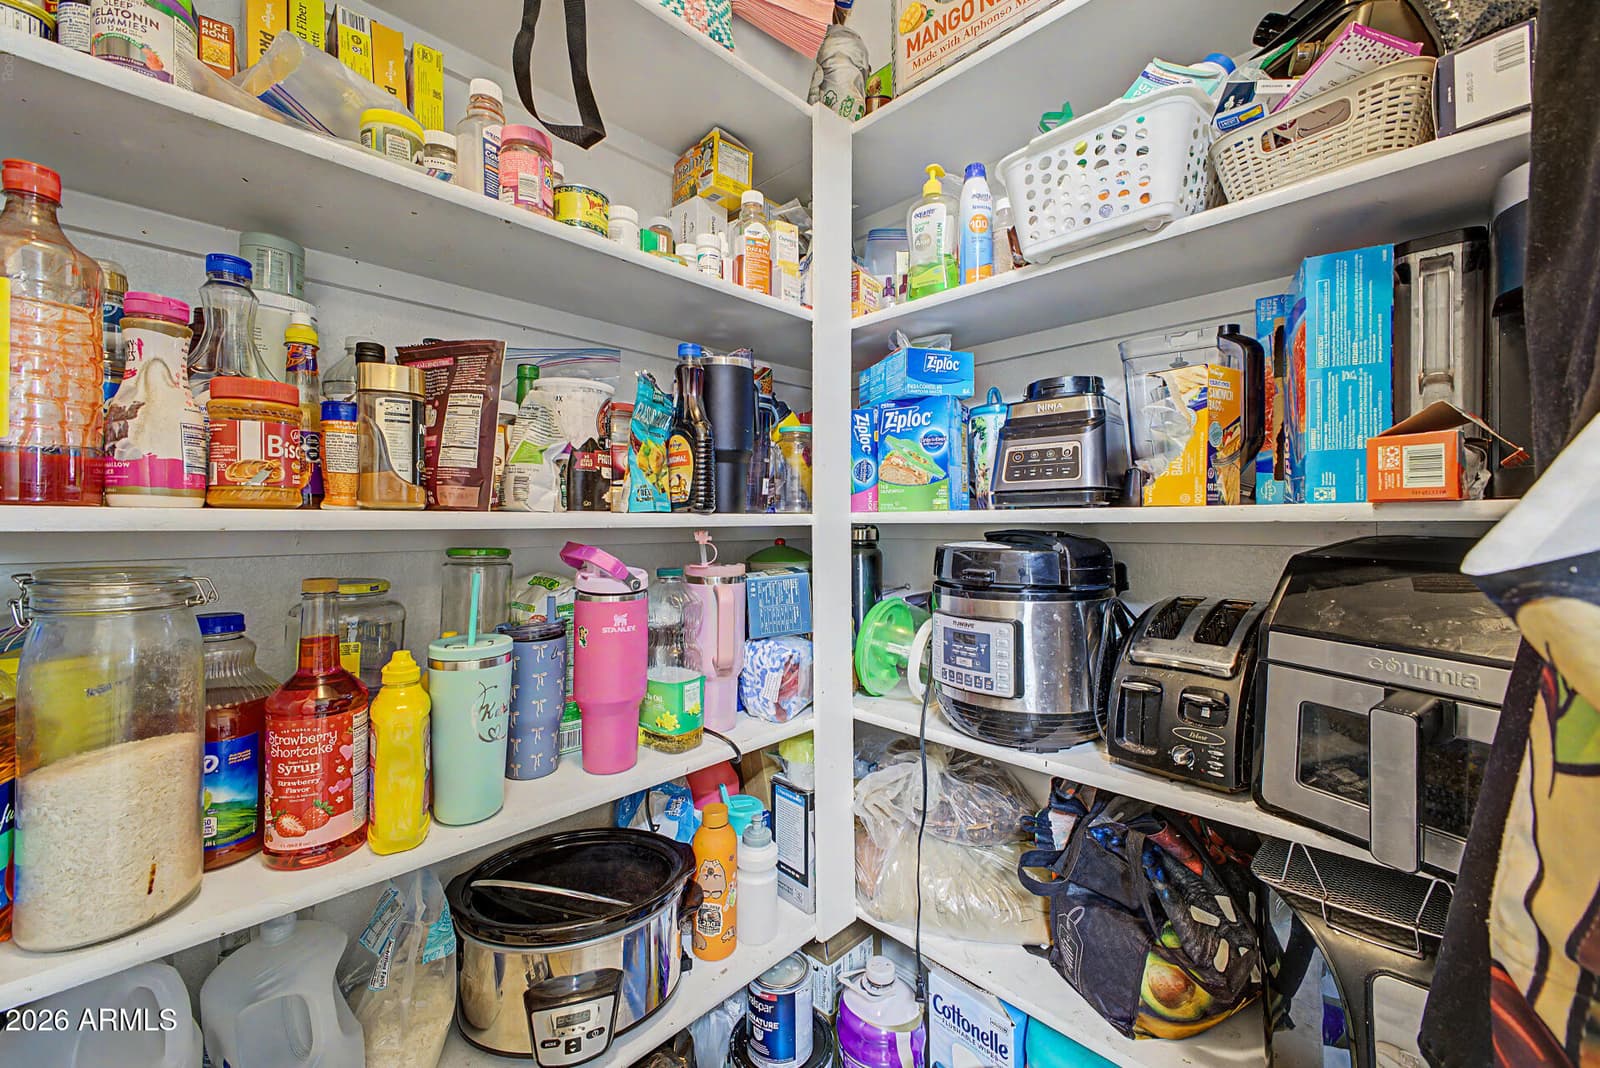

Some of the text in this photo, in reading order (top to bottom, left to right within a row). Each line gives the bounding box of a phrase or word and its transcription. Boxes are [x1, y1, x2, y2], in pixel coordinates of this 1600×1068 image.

[93, 7, 160, 30] ELATONIN
[95, 17, 147, 33] GUMMIES
[202, 19, 228, 33] RICE
[906, 0, 975, 59] MANGO
[911, 50, 938, 70] Made
[939, 35, 961, 54] with
[963, 5, 1013, 40] Alphonso
[926, 355, 960, 373] Ziploc
[1037, 403, 1063, 413] NINJA
[885, 410, 932, 433] Ziploc
[854, 413, 872, 454] Ziploc
[602, 625, 637, 634] STANLEY
[269, 730, 338, 746] Strawberry
[271, 743, 334, 758] Shortcake
[278, 762, 320, 775] Syrup
[933, 994, 1009, 1060] Cottonelle
